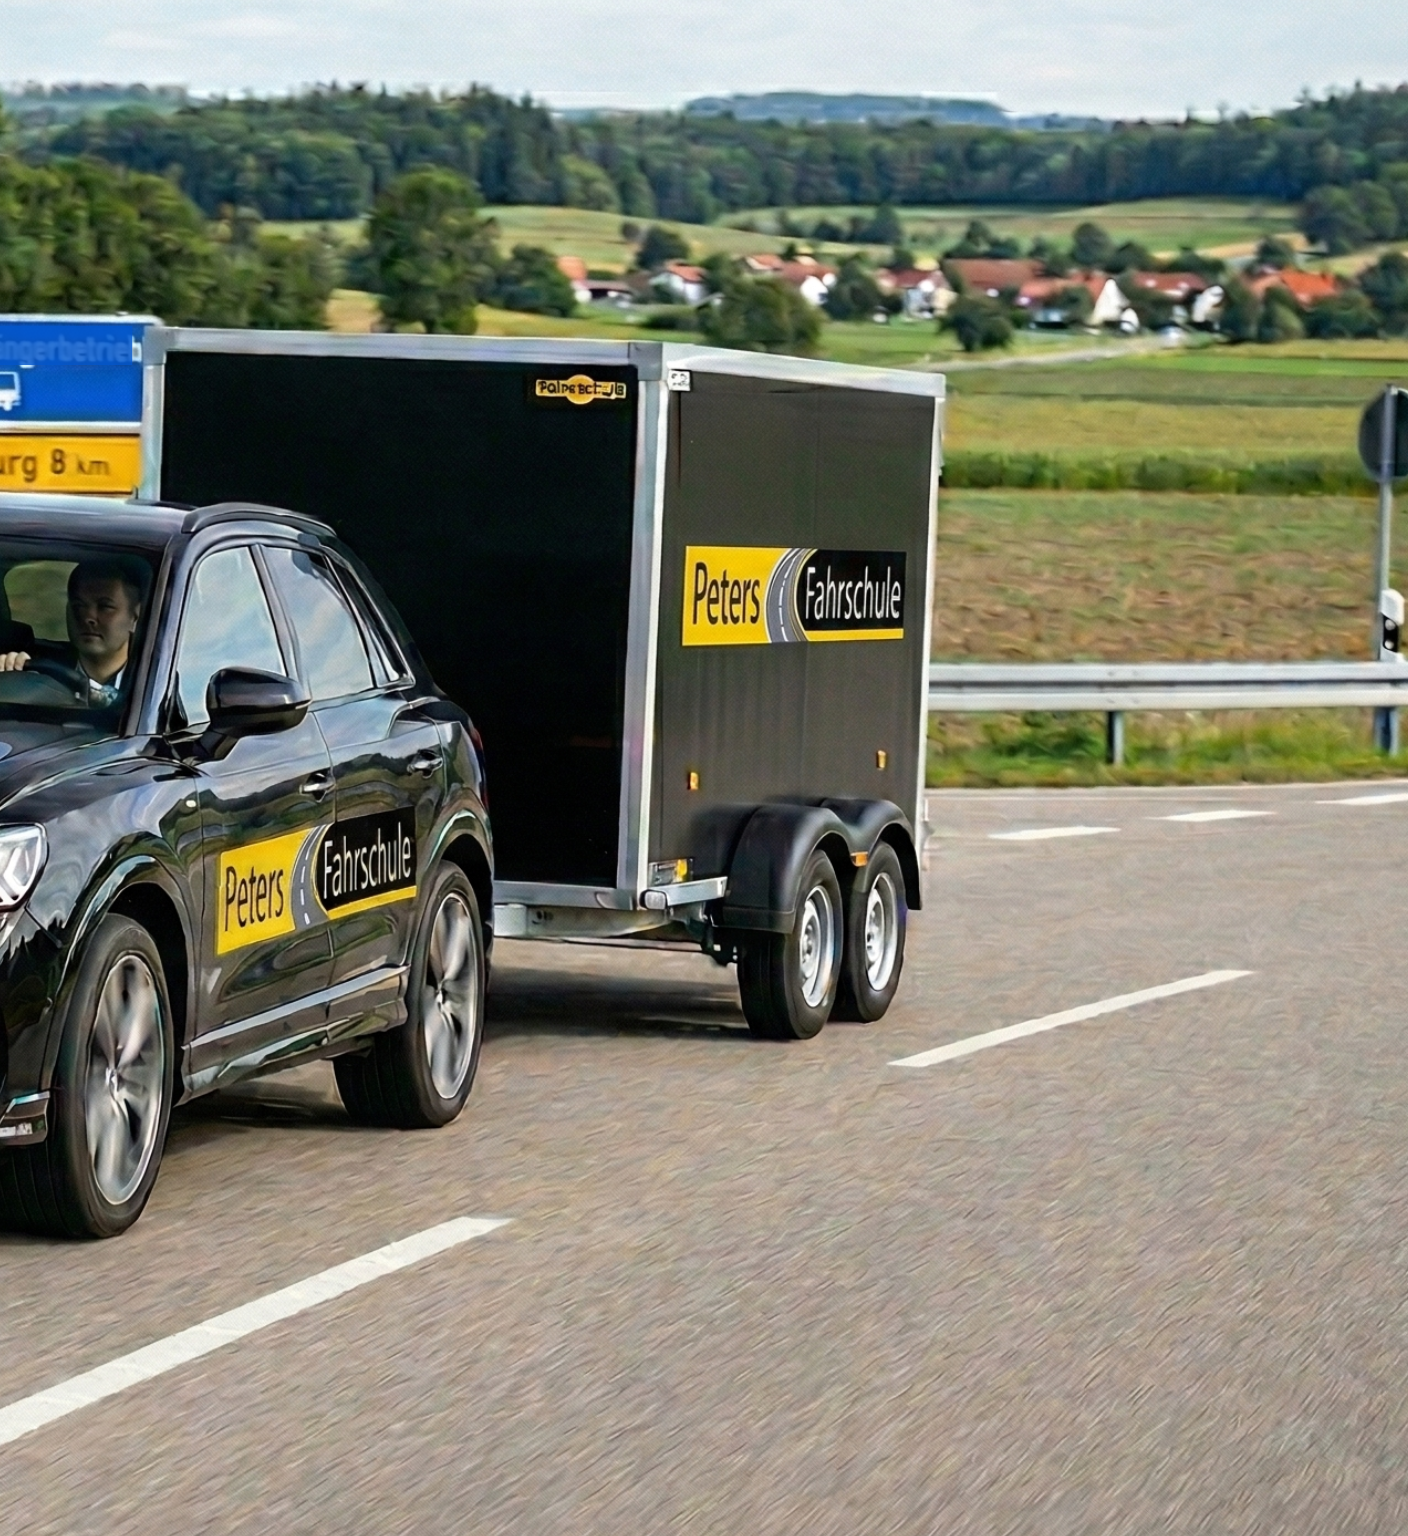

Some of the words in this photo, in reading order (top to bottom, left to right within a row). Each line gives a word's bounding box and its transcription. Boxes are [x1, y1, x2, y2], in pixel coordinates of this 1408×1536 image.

[50, 448, 66, 475] 8
[76, 454, 111, 476] km
[692, 561, 761, 625] Peters
[804, 565, 901, 620] Fahrschule
[224, 866, 285, 932] Peters
[323, 821, 412, 900] Fahrschule
